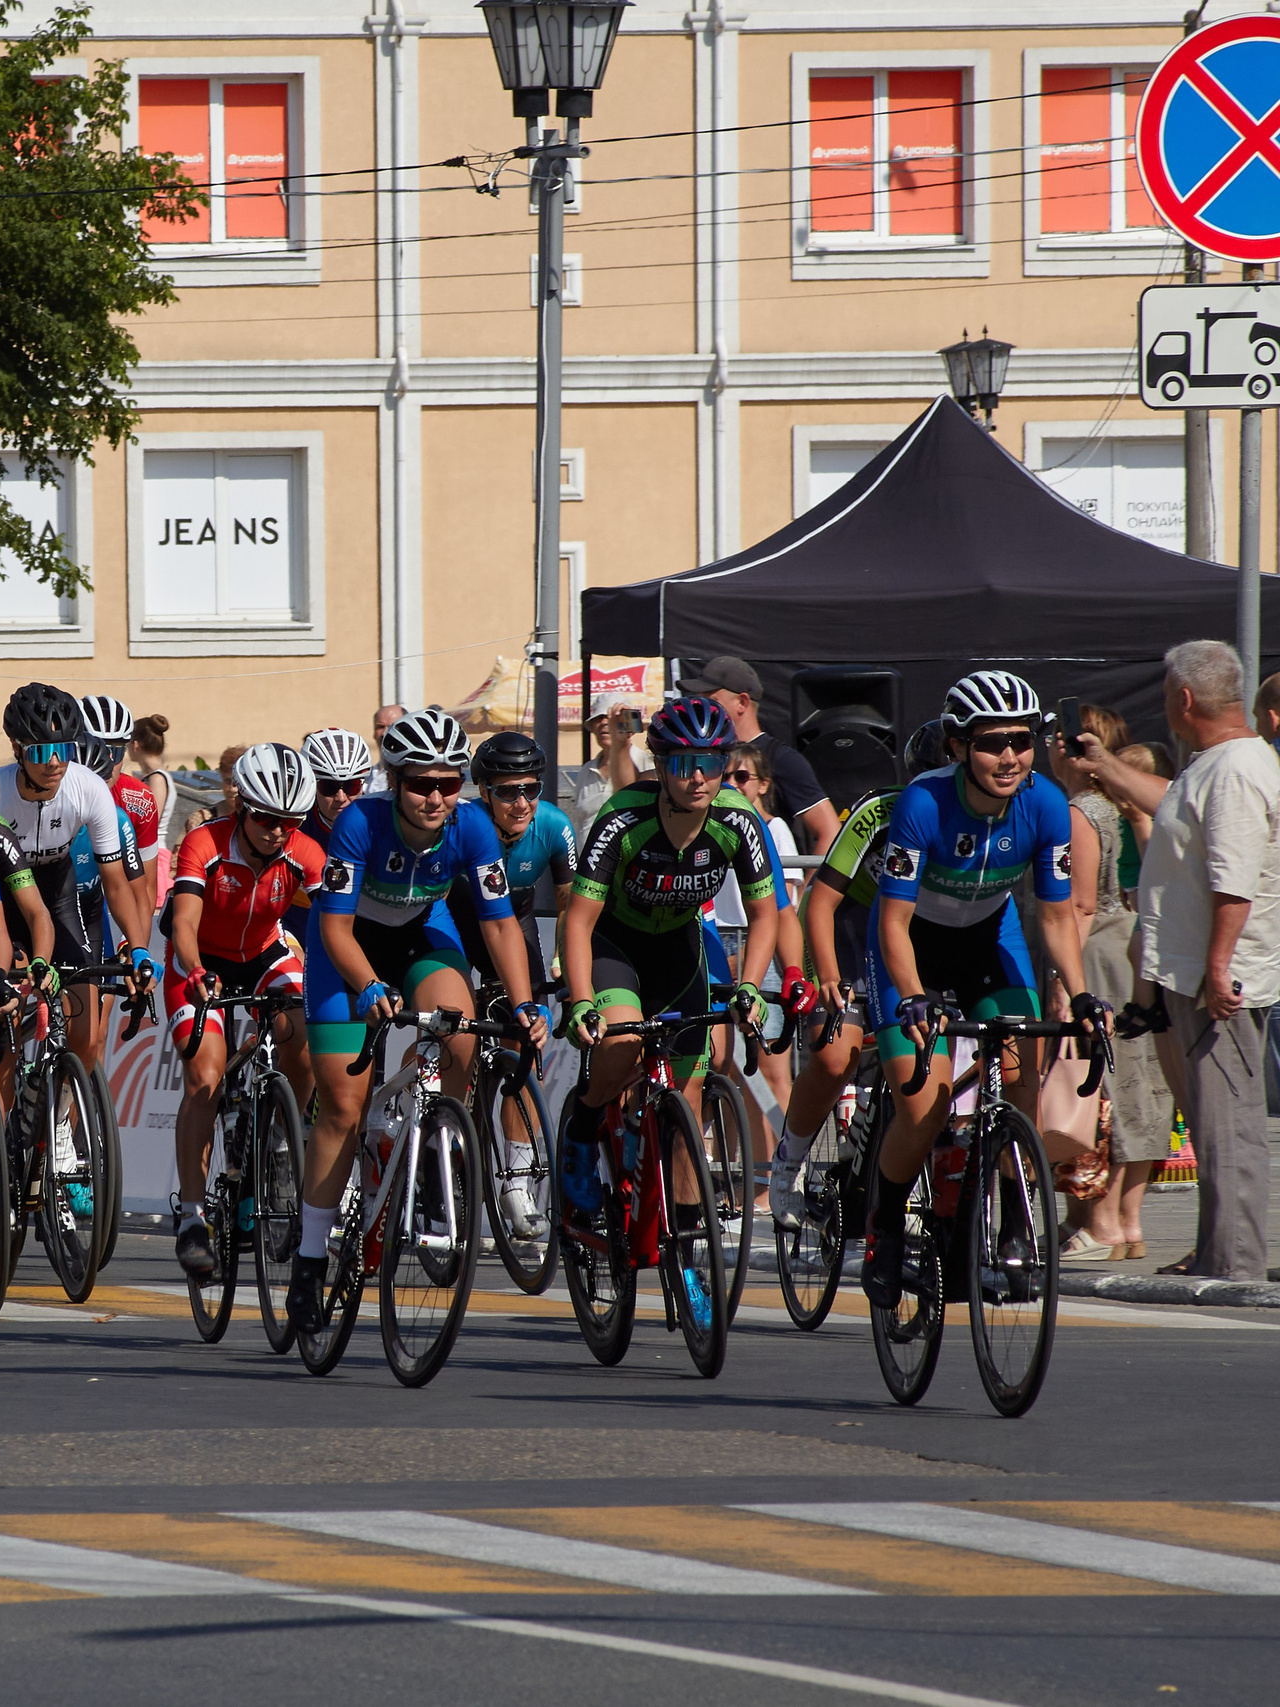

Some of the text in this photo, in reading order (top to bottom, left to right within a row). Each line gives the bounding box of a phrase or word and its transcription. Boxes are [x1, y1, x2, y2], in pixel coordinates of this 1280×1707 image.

[158, 517, 279, 546] JEANS
[121, 821, 139, 872] MAIKOP
[561, 825, 579, 871] MAIKOP
[586, 811, 639, 872] MICHE
[723, 811, 765, 873] MICHE
[624, 879, 676, 902] OLYMPIC
[629, 864, 726, 892] SESTRORETSK
[869, 950, 884, 1026] ХАБАРОВСКИЙ
